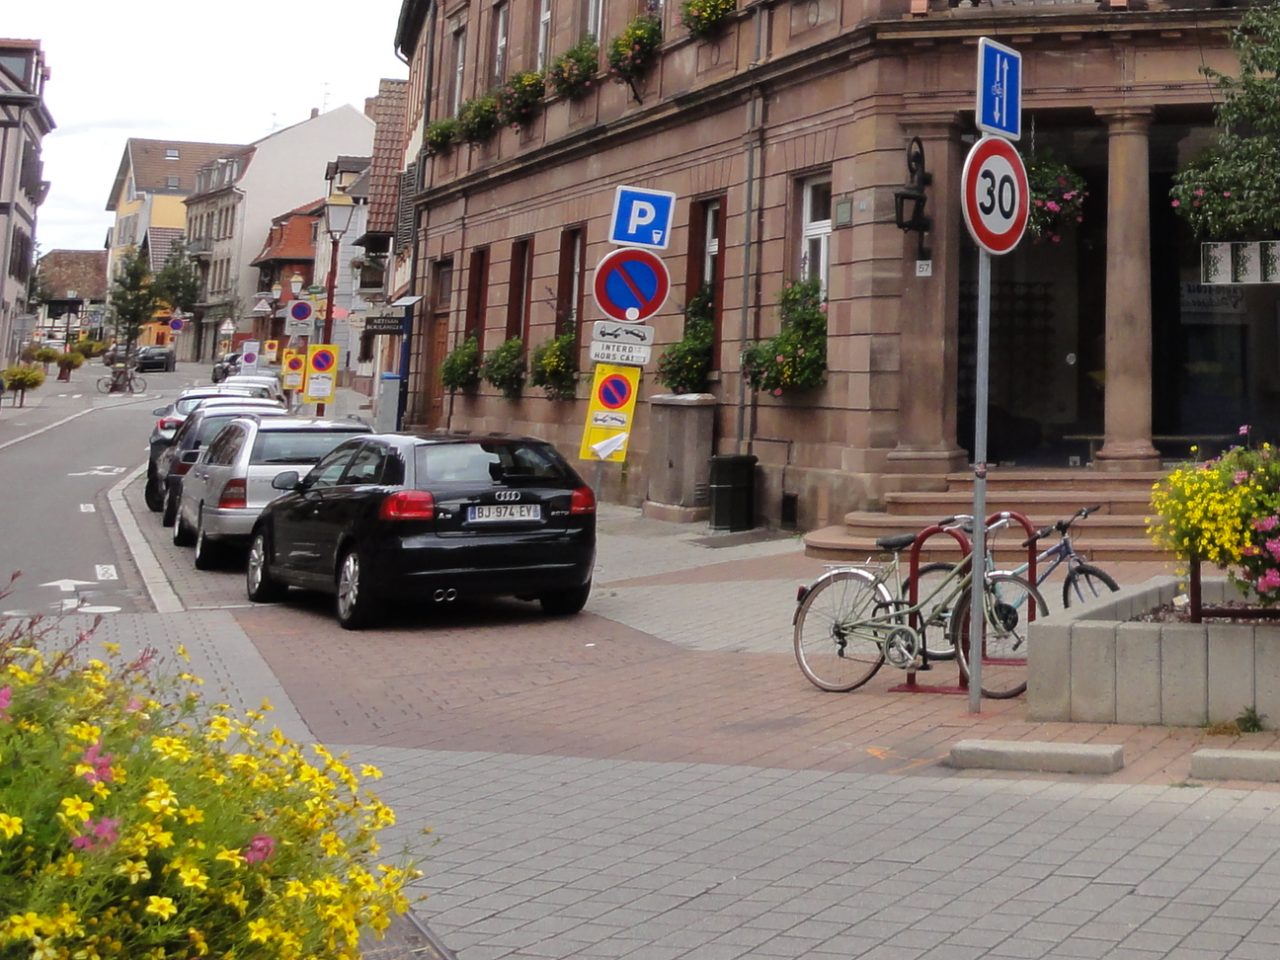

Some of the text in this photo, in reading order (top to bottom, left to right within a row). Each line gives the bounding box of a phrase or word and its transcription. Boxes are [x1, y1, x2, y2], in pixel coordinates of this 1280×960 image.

[979, 169, 1016, 220] 30
[627, 200, 656, 234] P
[919, 264, 930, 273] 57
[594, 351, 617, 360] HORS
